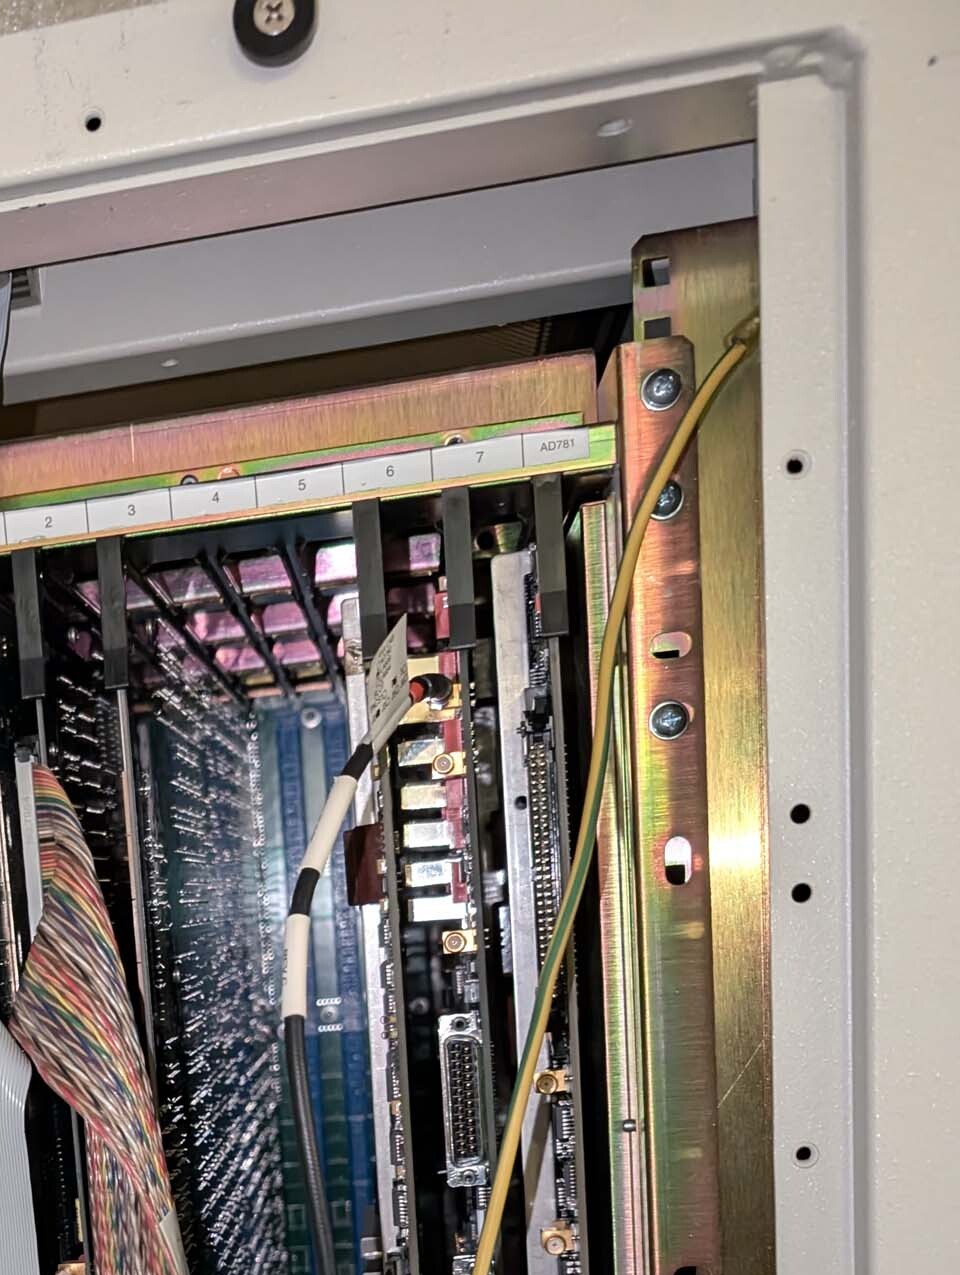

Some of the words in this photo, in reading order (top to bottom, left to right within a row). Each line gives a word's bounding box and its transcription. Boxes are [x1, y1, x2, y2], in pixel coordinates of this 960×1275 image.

[45, 516, 53, 528] 2
[128, 504, 136, 516] 3
[212, 492, 220, 503] 4
[298, 479, 307, 491] 5
[386, 465, 395, 477] 6
[476, 451, 484, 463] 7
[540, 438, 575, 452] AD781
